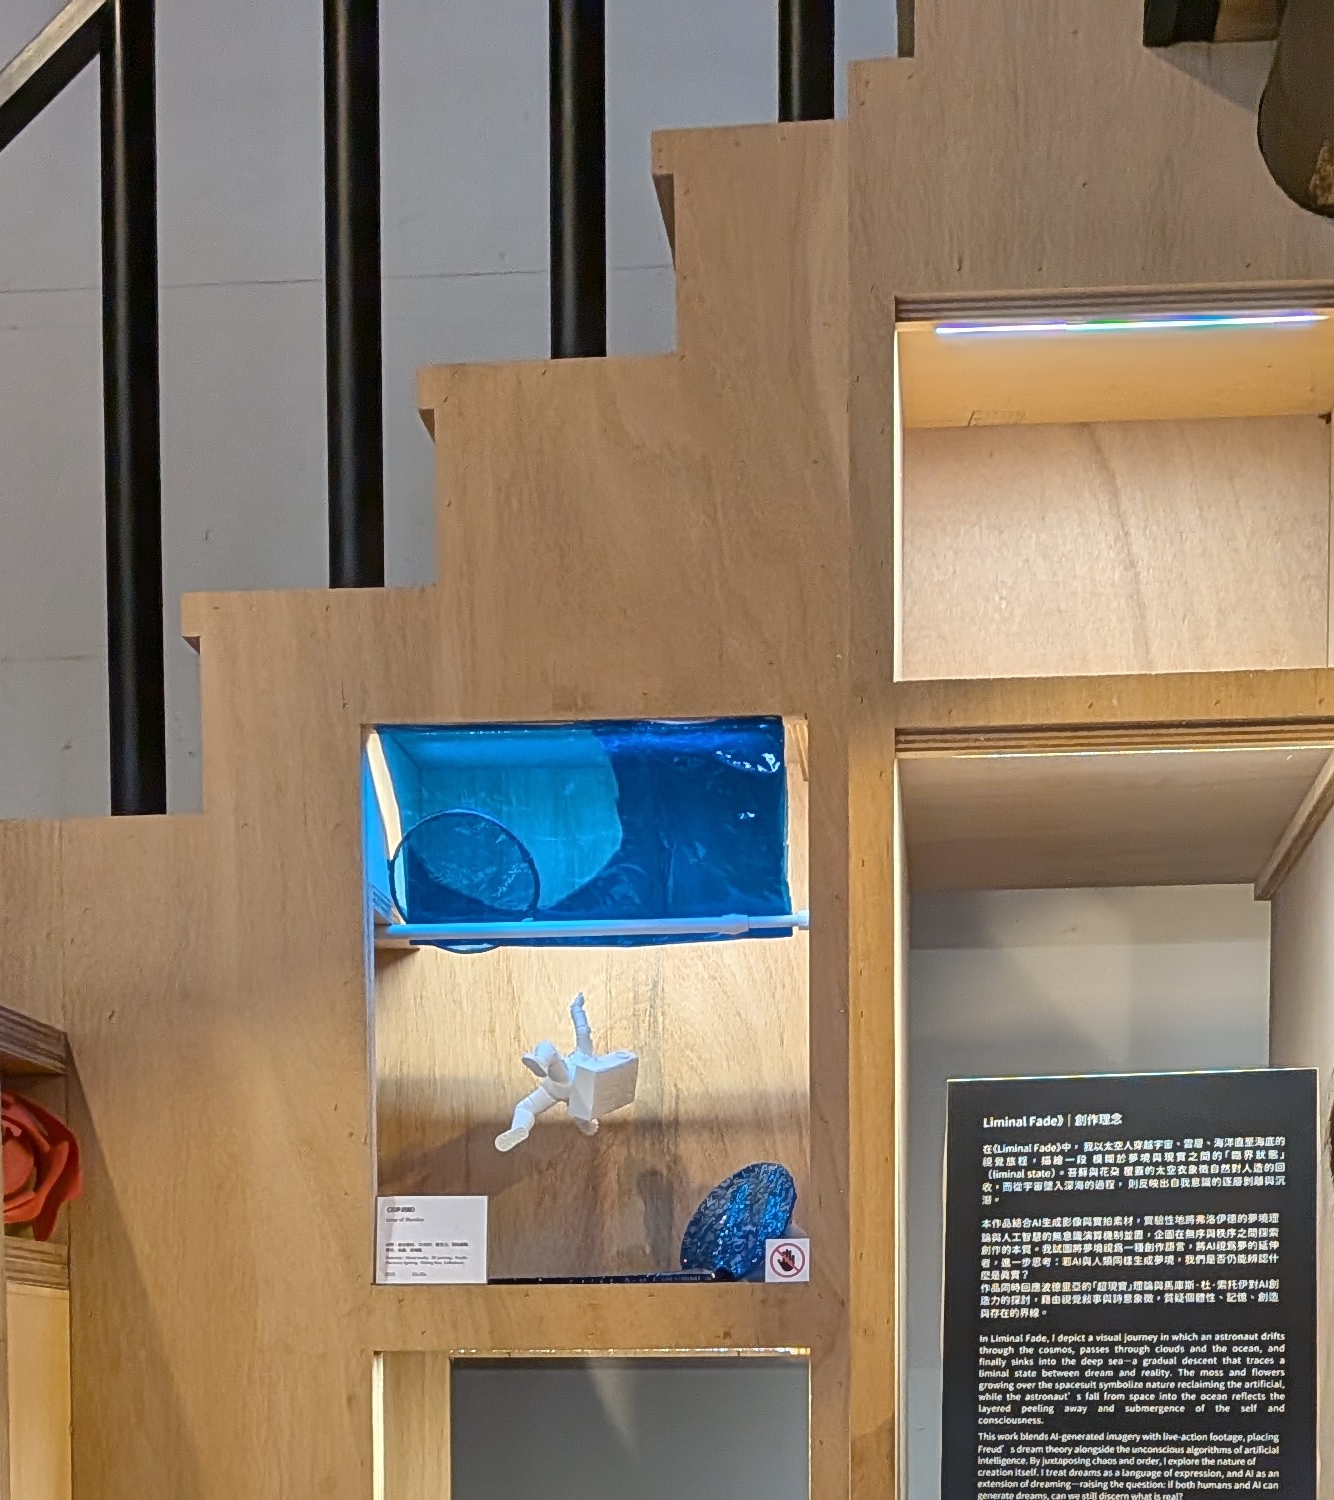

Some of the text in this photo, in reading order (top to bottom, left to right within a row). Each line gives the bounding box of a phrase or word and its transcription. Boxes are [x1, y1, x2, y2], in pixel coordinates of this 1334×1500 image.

[982, 1114, 1027, 1128] Liminal
[979, 1334, 988, 1342] In
[990, 1334, 1023, 1342] Liminal
[1025, 1333, 1049, 1343] Fade,
[1057, 1333, 1085, 1344] depict
[1095, 1333, 1122, 1341] visual
[1123, 1333, 1158, 1343] journey
[1171, 1332, 1198, 1341] which
[1214, 1332, 1258, 1340] astronaut
[1260, 1332, 1285, 1340] drifts
[978, 1345, 1014, 1356] through
[1018, 1345, 1034, 1353] the
[1038, 1346, 1075, 1355] cosmos,
[1079, 1346, 1109, 1355] passes
[1114, 1344, 1150, 1355] through
[1189, 1344, 1207, 1352] and
[1212, 1344, 1227, 1352] the
[1231, 1345, 1262, 1354] ocean,
[1267, 1344, 1285, 1352] and
[978, 1357, 1006, 1368] finally
[1010, 1357, 1034, 1365] sinks
[1038, 1357, 1056, 1365] into
[1061, 1356, 1076, 1365] the
[1080, 1356, 1103, 1367] deep
[1142, 1356, 1177, 1367] gradual
[1181, 1356, 1217, 1364] descent
[1222, 1356, 1241, 1364] that
[1246, 1355, 1274, 1364] traces
[978, 1369, 1009, 1377] liminal
[1014, 1368, 1037, 1377] state
[1041, 1368, 1080, 1377] between
[1084, 1368, 1113, 1377] dream
[1118, 1368, 1136, 1376] and
[1140, 1368, 1172, 1379] reality.
[1177, 1368, 1195, 1376] The
[1228, 1367, 1246, 1376] and
[1251, 1367, 1285, 1376] flowers
[978, 1380, 1014, 1391] growing
[1037, 1380, 1053, 1389] the
[1054, 1380, 1096, 1391] spacesuit
[1098, 1380, 1143, 1391] symbolize
[1145, 1380, 1175, 1388] nature
[1177, 1380, 1225, 1390] reclaiming
[1226, 1380, 1242, 1388] the
[1244, 1380, 1285, 1390] artificial,
[978, 1403, 1285, 1414] layered peeling away and submergence of the self and
[977, 1416, 1044, 1424] consciousness.
[977, 1432, 1279, 1443] This work blends AI-generated imagery with live-action footage, placing
[977, 1468, 1013, 1476] creation
[1045, 1468, 1066, 1476] treat
[1068, 1468, 1101, 1476] dreams
[1121, 1468, 1162, 1479] language
[1163, 1469, 1173, 1477] of
[1174, 1469, 1224, 1479] expression,
[1226, 1469, 1243, 1477] and
[1244, 1469, 1254, 1477] AI
[977, 1479, 1018, 1487] extension
[1019, 1479, 1029, 1487] of
[1109, 1480, 1124, 1488] the
[1125, 1480, 1165, 1491] question:
[1174, 1480, 1195, 1488] both
[1197, 1480, 1232, 1489] humans
[1233, 1480, 1250, 1489] and
[1251, 1481, 1261, 1489] AI
[1015, 1491, 1049, 1500] dreams,
[1081, 1492, 1097, 1500] still
[1098, 1492, 1129, 1500] discern
[1130, 1492, 1152, 1500] what
[1153, 1492, 1161, 1500] is
[1162, 1492, 1183, 1500] real?
